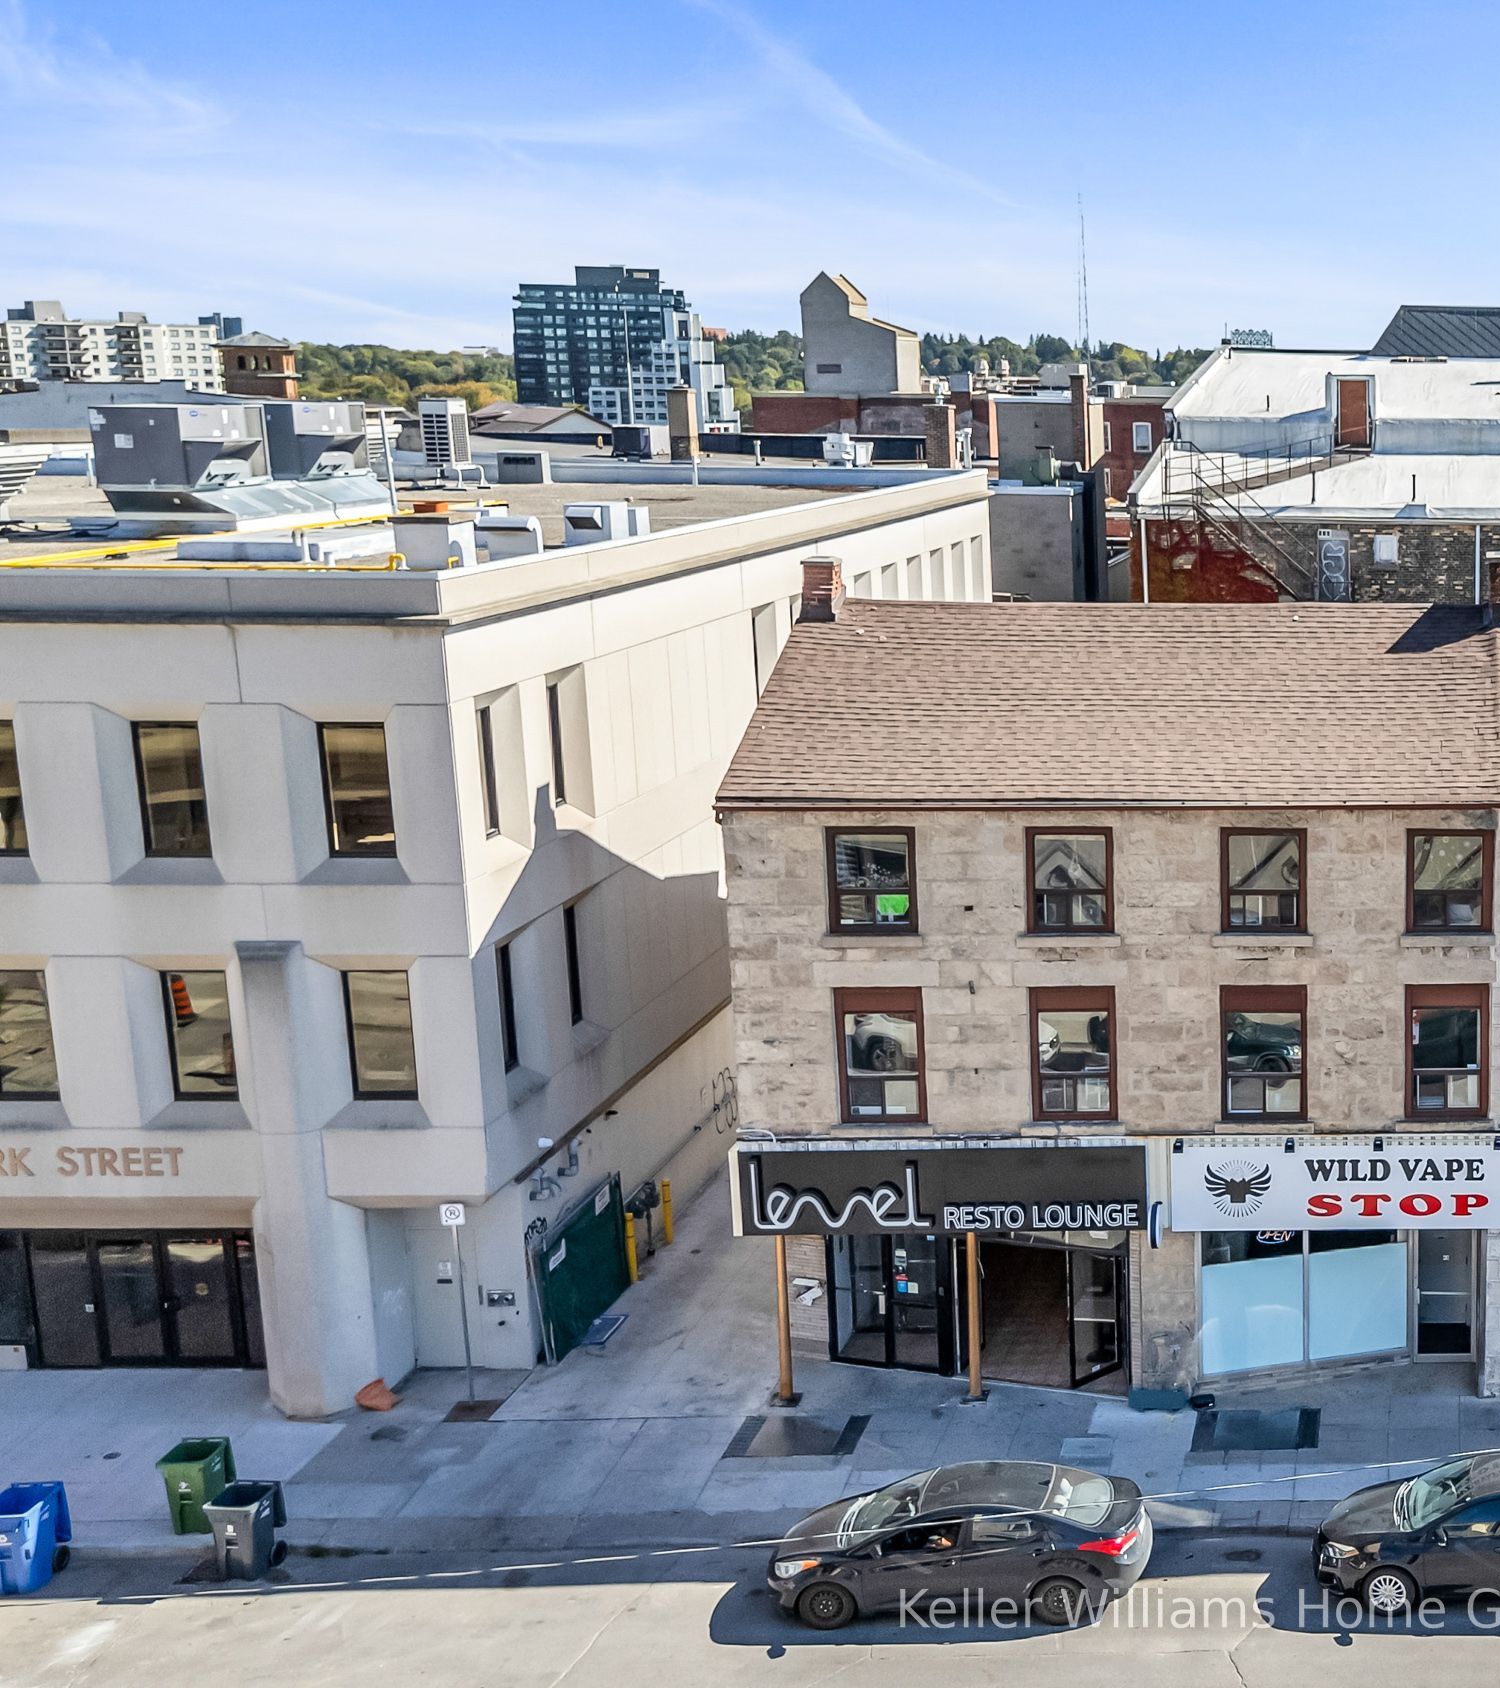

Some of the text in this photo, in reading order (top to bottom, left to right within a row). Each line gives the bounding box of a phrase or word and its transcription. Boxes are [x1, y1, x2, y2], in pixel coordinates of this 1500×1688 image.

[56, 1146, 184, 1177] STREET
[1304, 1158, 1485, 1182] WILD VAPE
[943, 1203, 1139, 1230] RESTO LOUNGE
[1306, 1193, 1490, 1217] STOP
